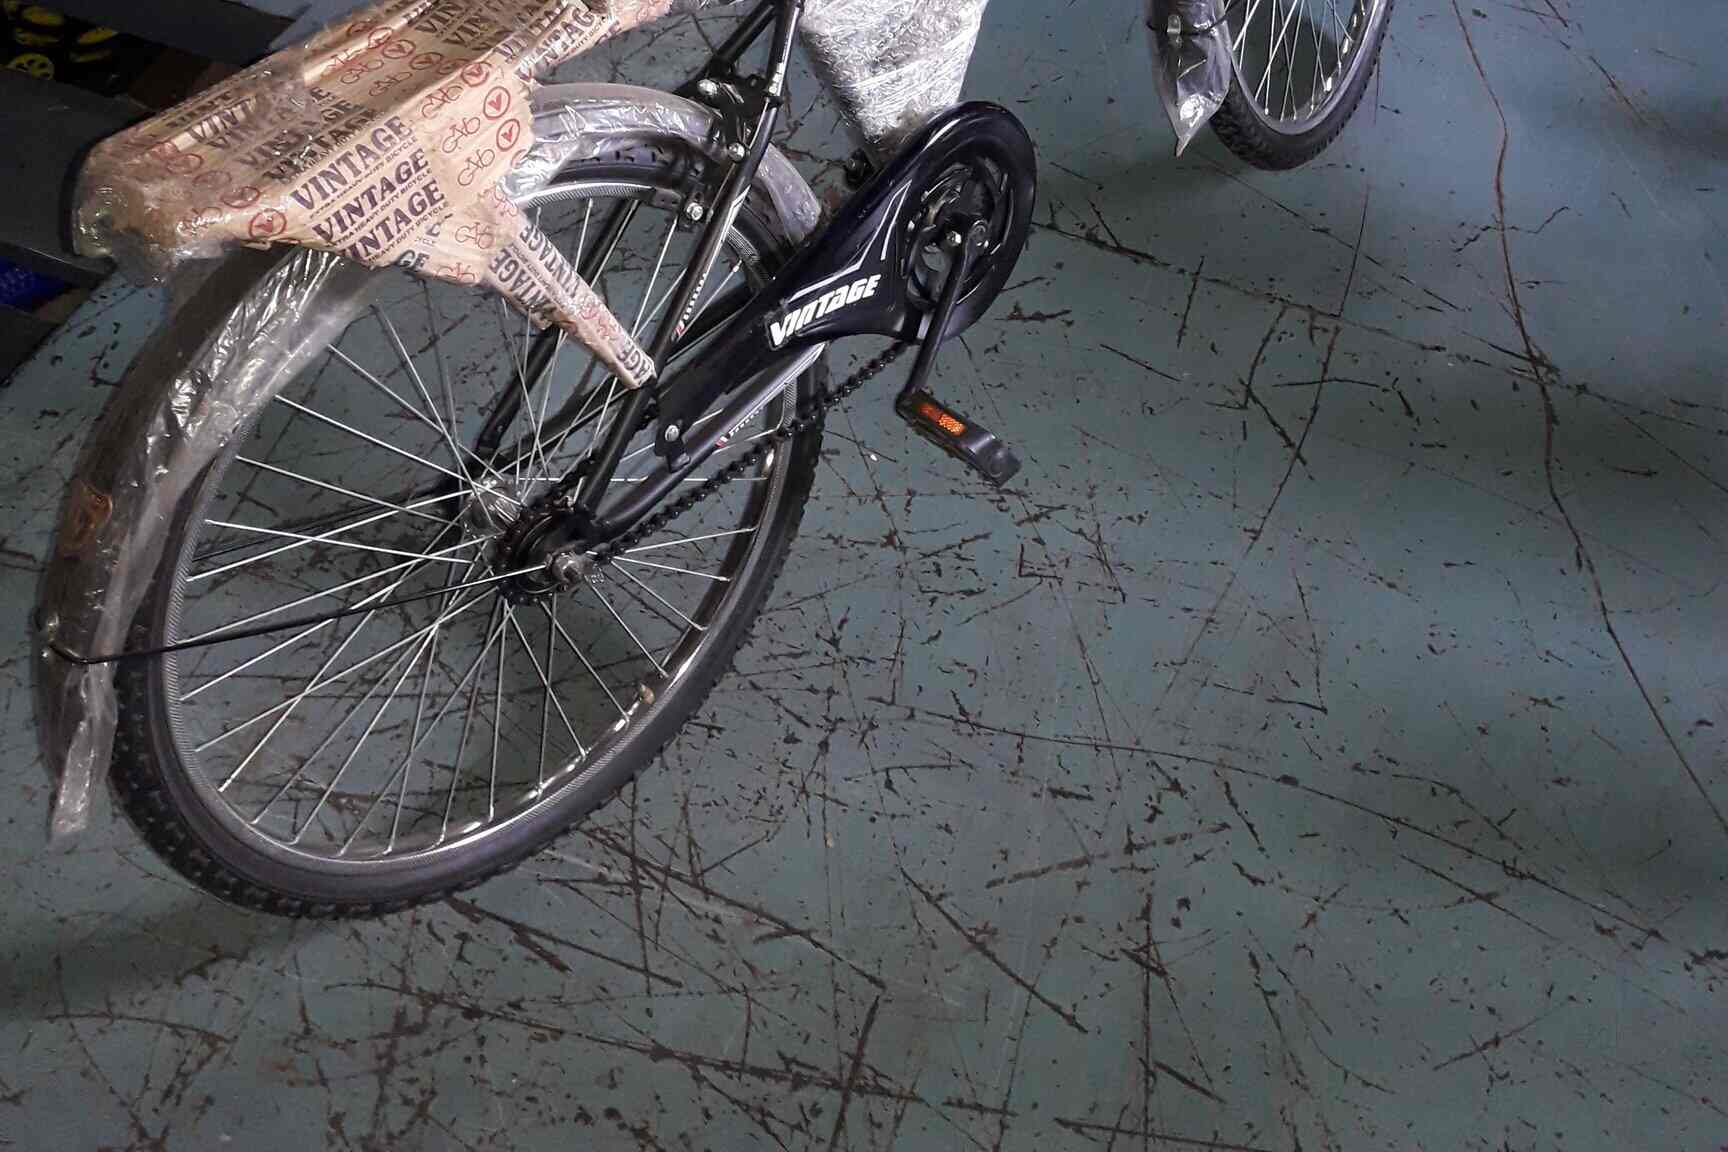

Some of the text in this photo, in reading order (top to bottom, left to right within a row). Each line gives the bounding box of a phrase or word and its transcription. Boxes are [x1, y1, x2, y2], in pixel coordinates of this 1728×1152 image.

[290, 115, 413, 210] VINTAGE
[384, 135, 417, 163] BICYCLE
[312, 148, 428, 241] VINTAGE
[347, 179, 445, 260] INTAGE
[354, 211, 379, 232] HEAVY
[379, 192, 400, 211] DUTY
[400, 168, 432, 194] BICYCLE
[394, 225, 416, 244] DUTY
[415, 200, 449, 226] BICYCLE
